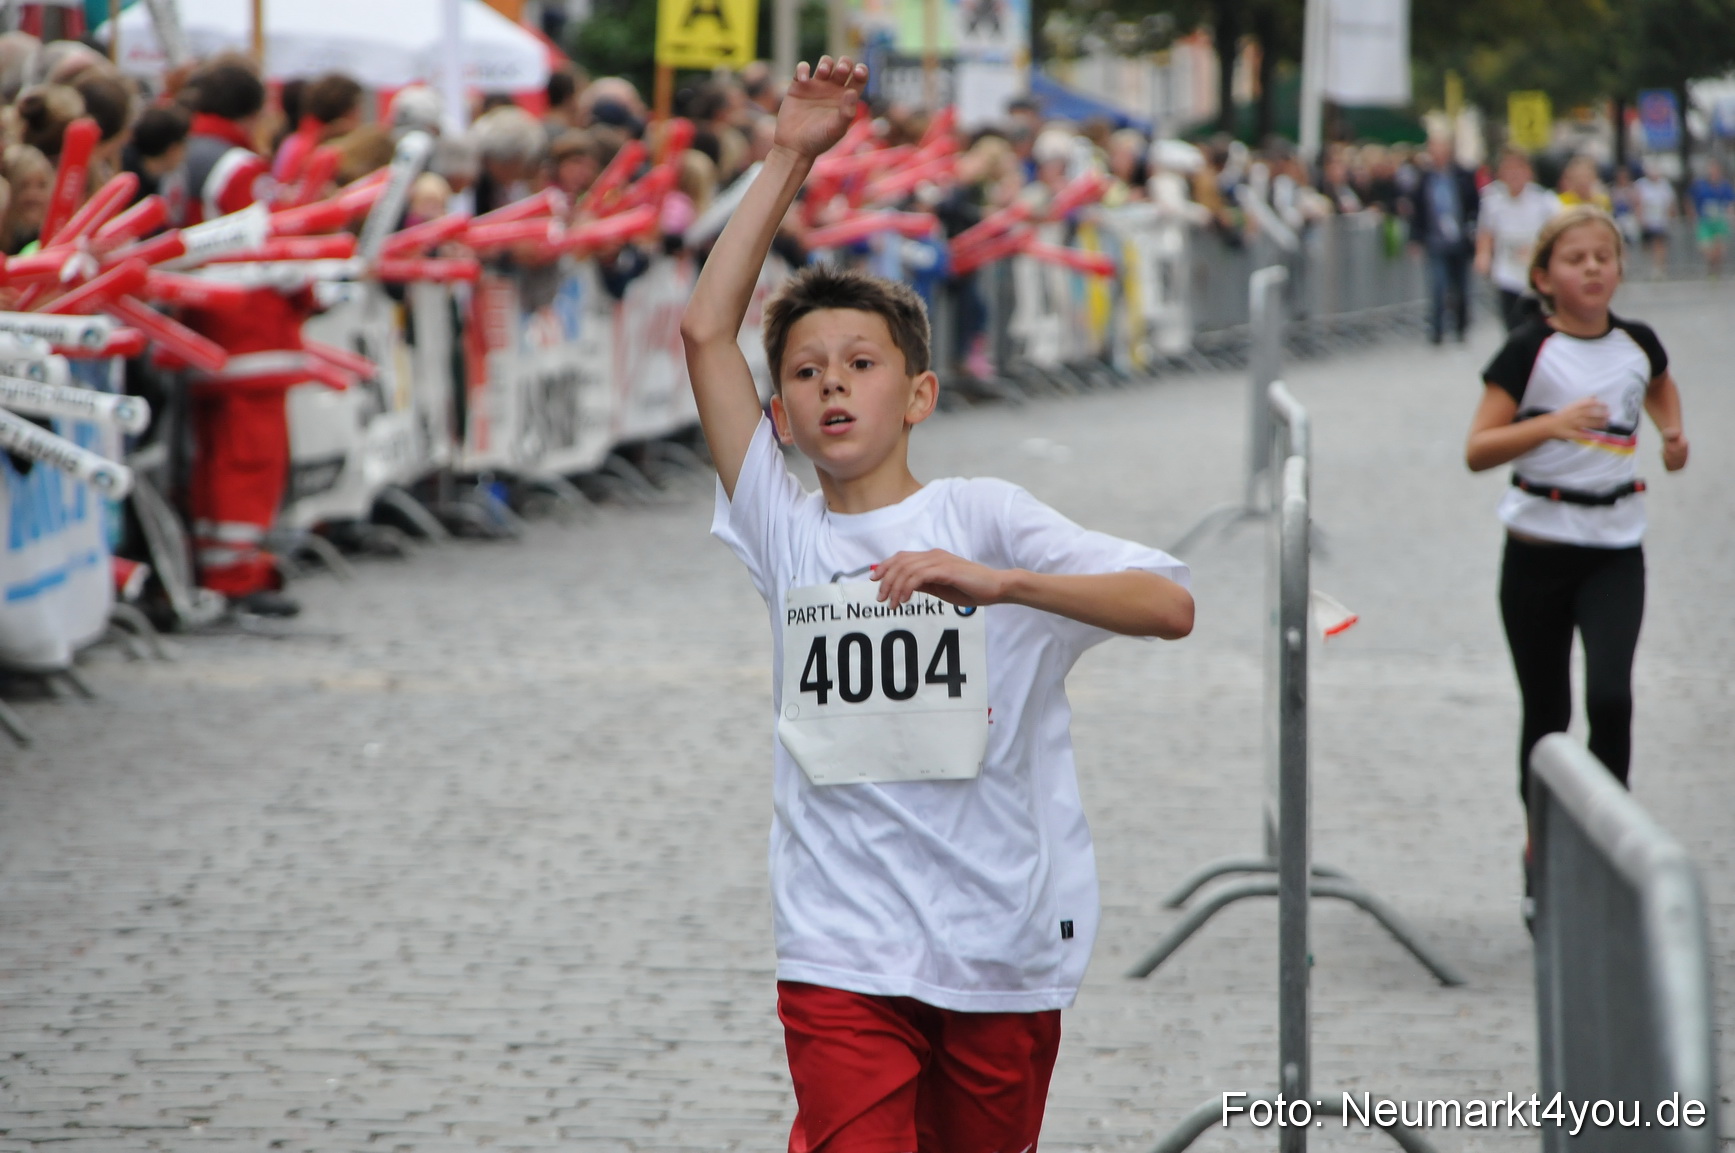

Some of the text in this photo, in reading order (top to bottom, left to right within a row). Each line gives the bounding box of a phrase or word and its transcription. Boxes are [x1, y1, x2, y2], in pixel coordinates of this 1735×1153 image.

[787, 599, 945, 626] PARTL Neumarkt
[800, 629, 967, 705] 4004
